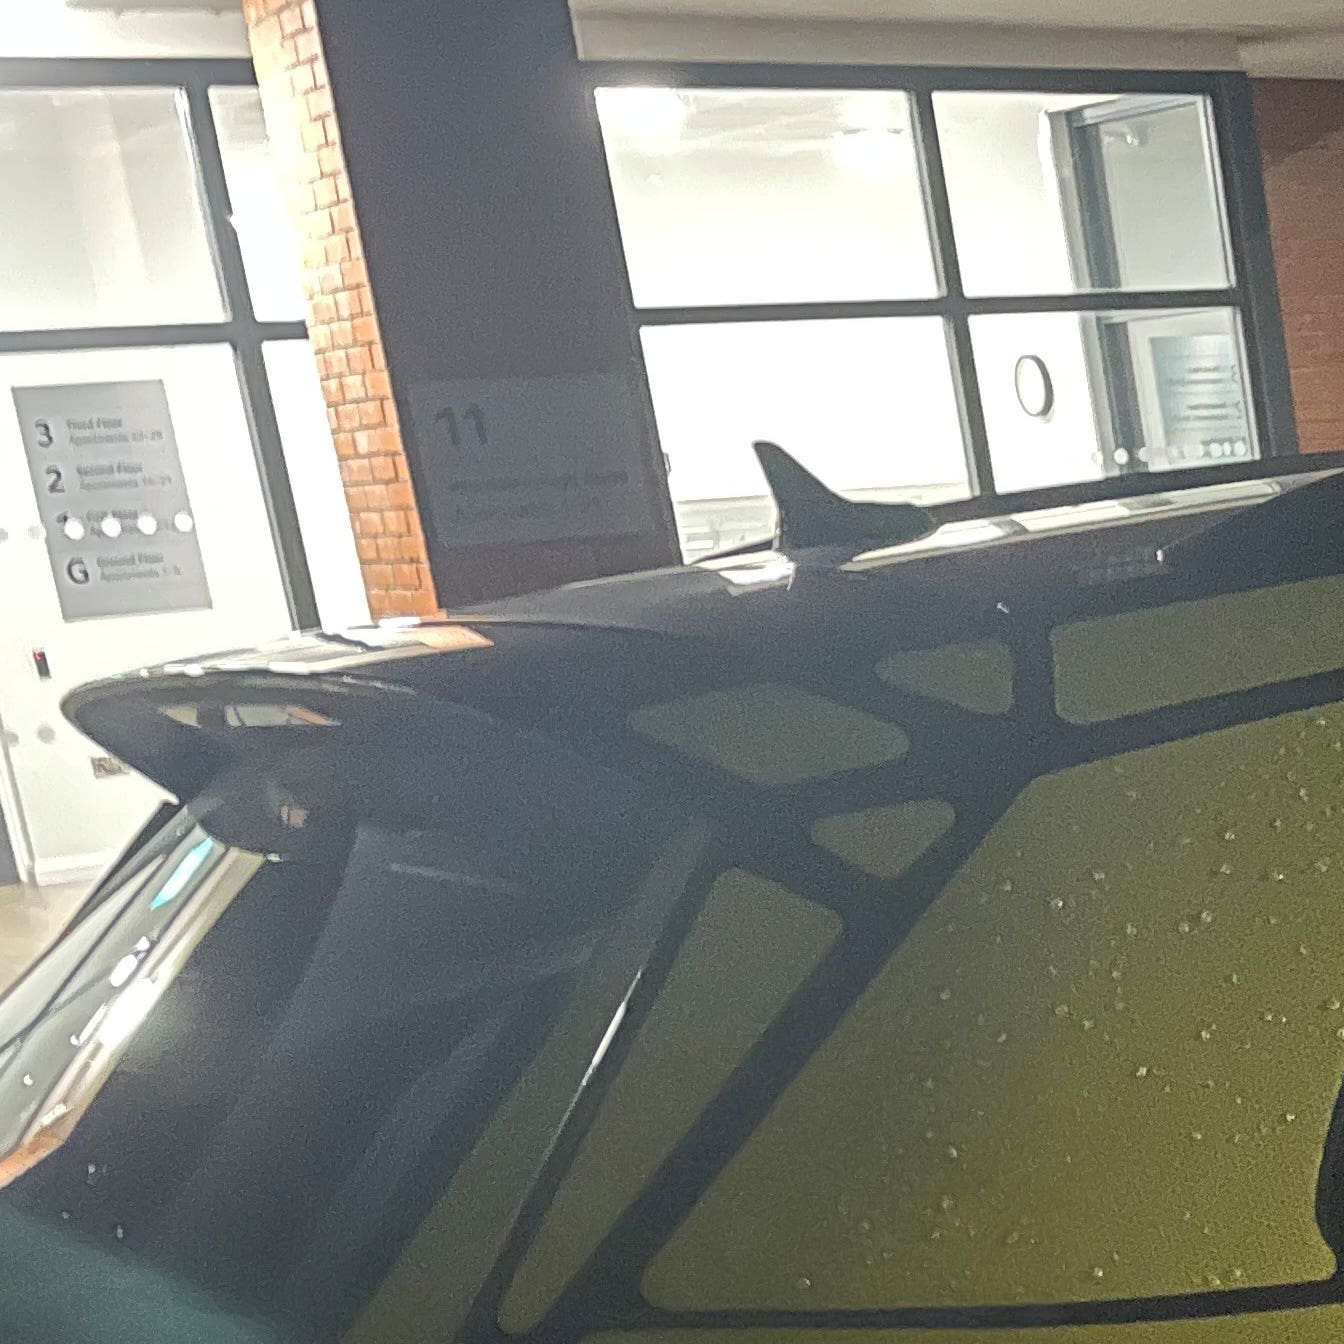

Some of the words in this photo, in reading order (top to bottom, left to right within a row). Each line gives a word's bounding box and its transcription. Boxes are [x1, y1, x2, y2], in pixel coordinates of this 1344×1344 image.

[34, 418, 53, 448] 3
[434, 403, 488, 447] 11
[45, 464, 65, 493] 2
[67, 557, 90, 585] G
